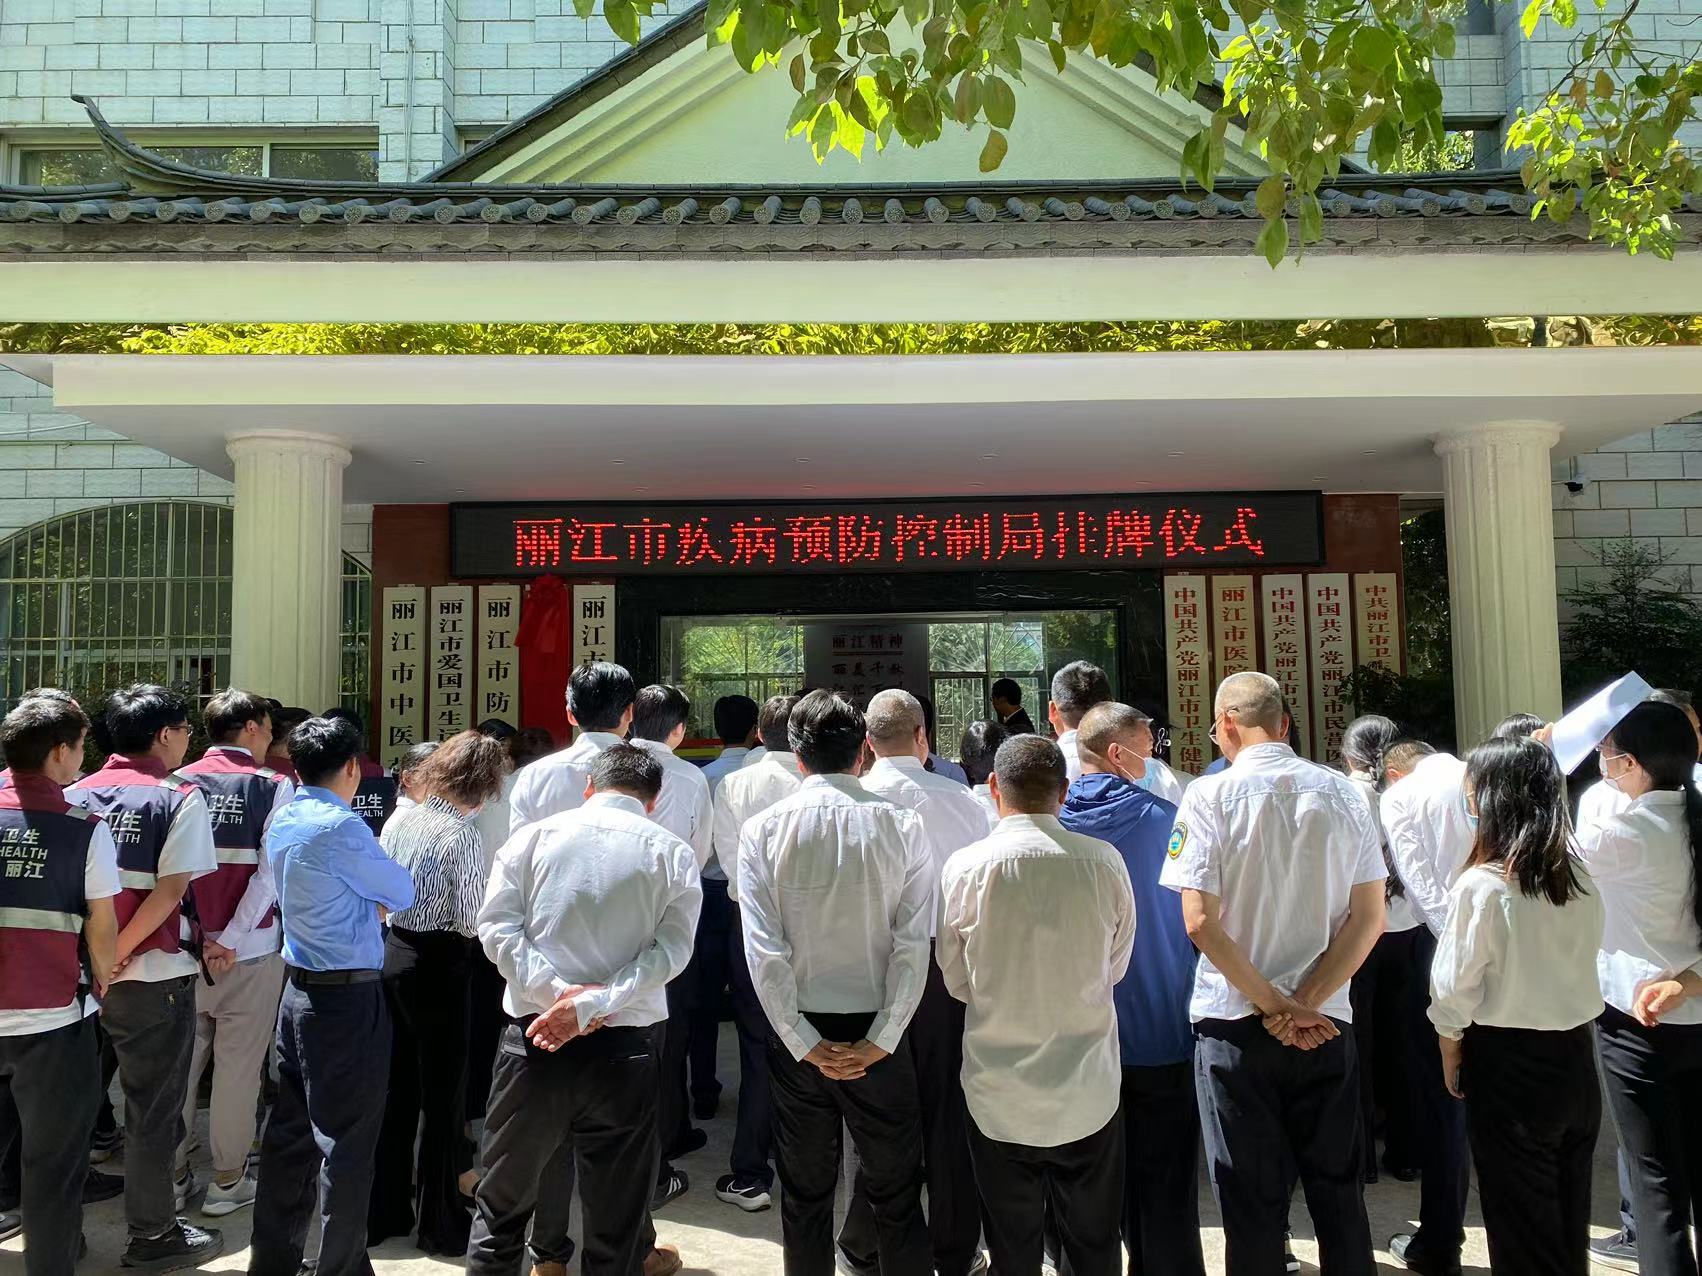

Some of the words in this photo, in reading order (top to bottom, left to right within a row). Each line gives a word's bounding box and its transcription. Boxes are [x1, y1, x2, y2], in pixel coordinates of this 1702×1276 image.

[512, 507, 1264, 567] 丽江市疾病预防控制局挂牌仪式
[486, 597, 512, 713] 丽江市防
[580, 595, 607, 665] 丽江市
[1271, 587, 1301, 723] 中国共产党丽江市
[1365, 585, 1392, 669] 中共丽江市卫
[389, 598, 417, 769] 丽江市中医
[352, 793, 383, 810] 卫生
[354, 809, 384, 818] EALTH
[0, 845, 49, 860] HEALTH
[5, 860, 45, 879] 丽江
